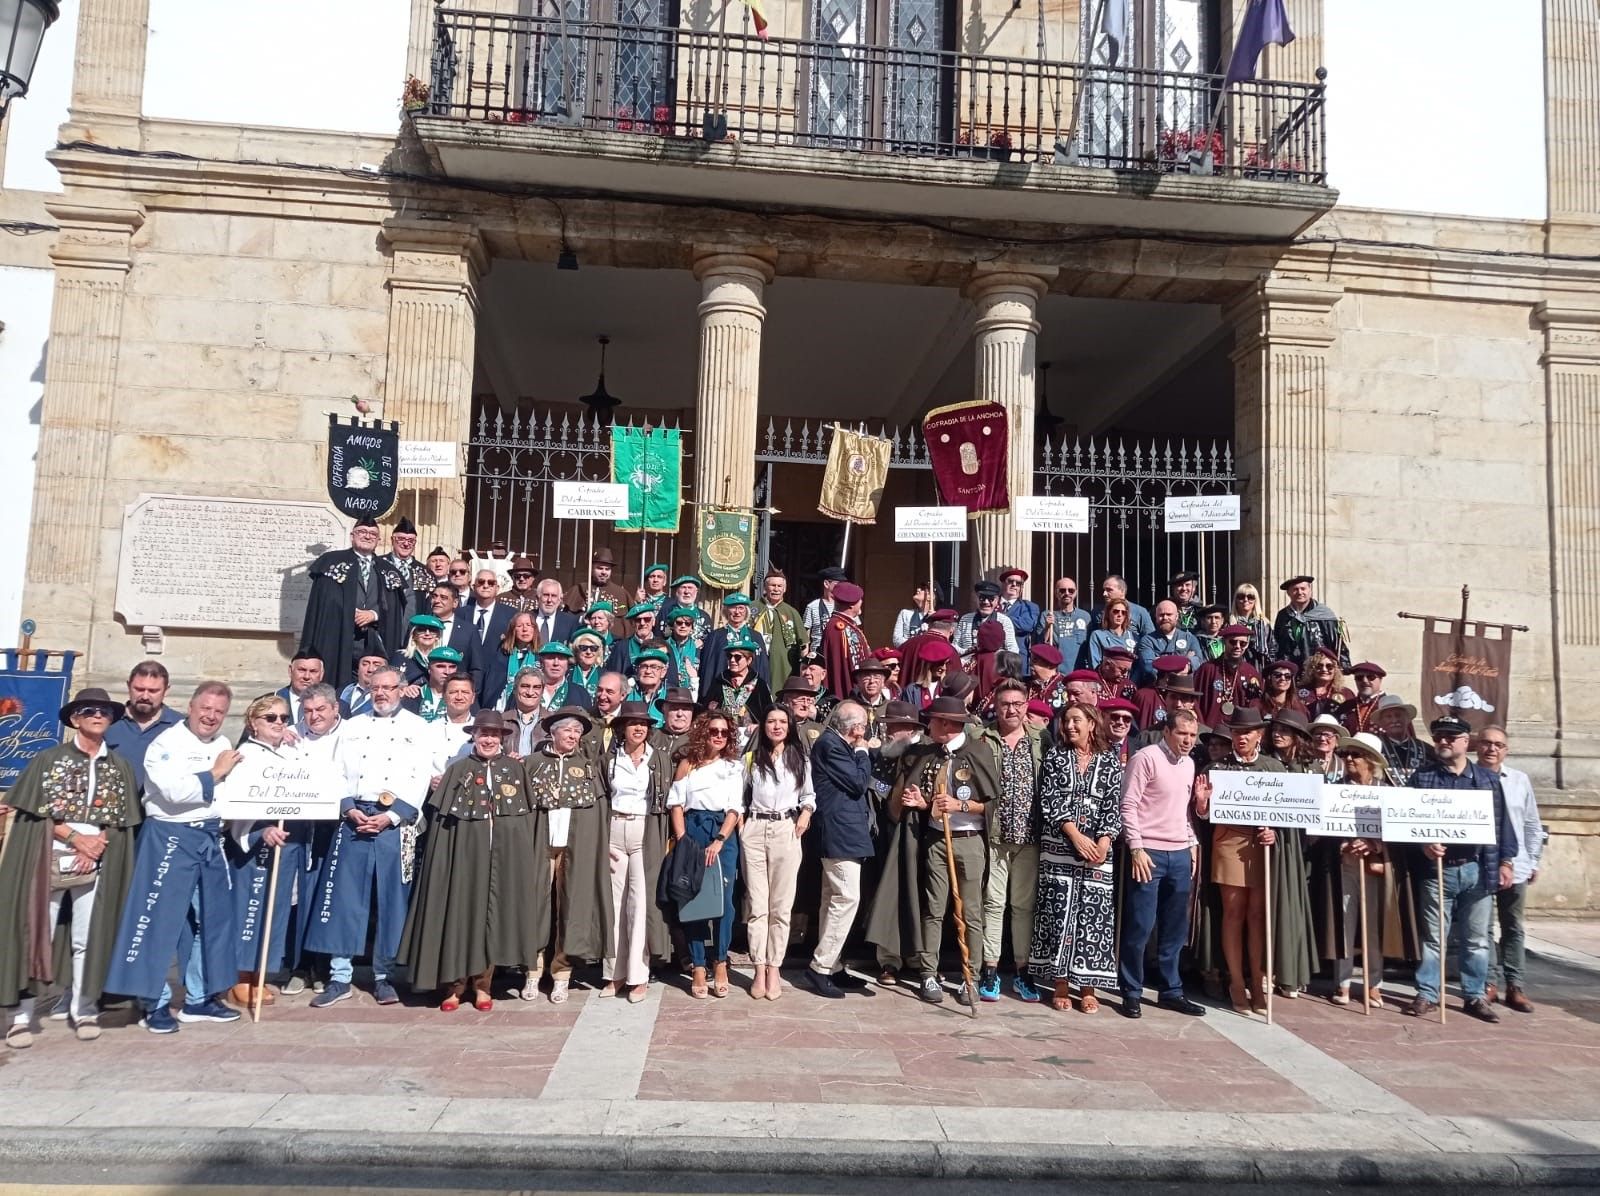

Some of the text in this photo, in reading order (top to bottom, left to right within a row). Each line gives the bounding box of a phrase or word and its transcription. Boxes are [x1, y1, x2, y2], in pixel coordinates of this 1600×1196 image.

[926, 417, 959, 430] COFRADIA
[960, 415, 967, 423] DE
[977, 411, 1003, 420] ANCHOA
[346, 434, 382, 450] AMIGOS
[381, 456, 392, 487] DE LOS
[344, 496, 379, 511] NABOS
[567, 508, 616, 517] CABRANES
[1032, 521, 1074, 529] ASTURIAS
[248, 785, 320, 799] Del Desarme
[1219, 790, 1315, 804] del Queso de Gamoneu
[266, 806, 301, 815] OVIEDO
[1329, 803, 1340, 813] de
[1387, 807, 1398, 818] De
[1408, 807, 1432, 819] Buena
[1214, 809, 1320, 824] CANGAS DE ONIS-ONIS
[1410, 827, 1467, 839] SALINAS
[329, 859, 338, 878] del
[252, 876, 264, 894] del
[146, 892, 160, 911] del
[320, 881, 335, 923] Desarme
[241, 899, 260, 941] Desarme
[126, 915, 151, 962] Desarme
